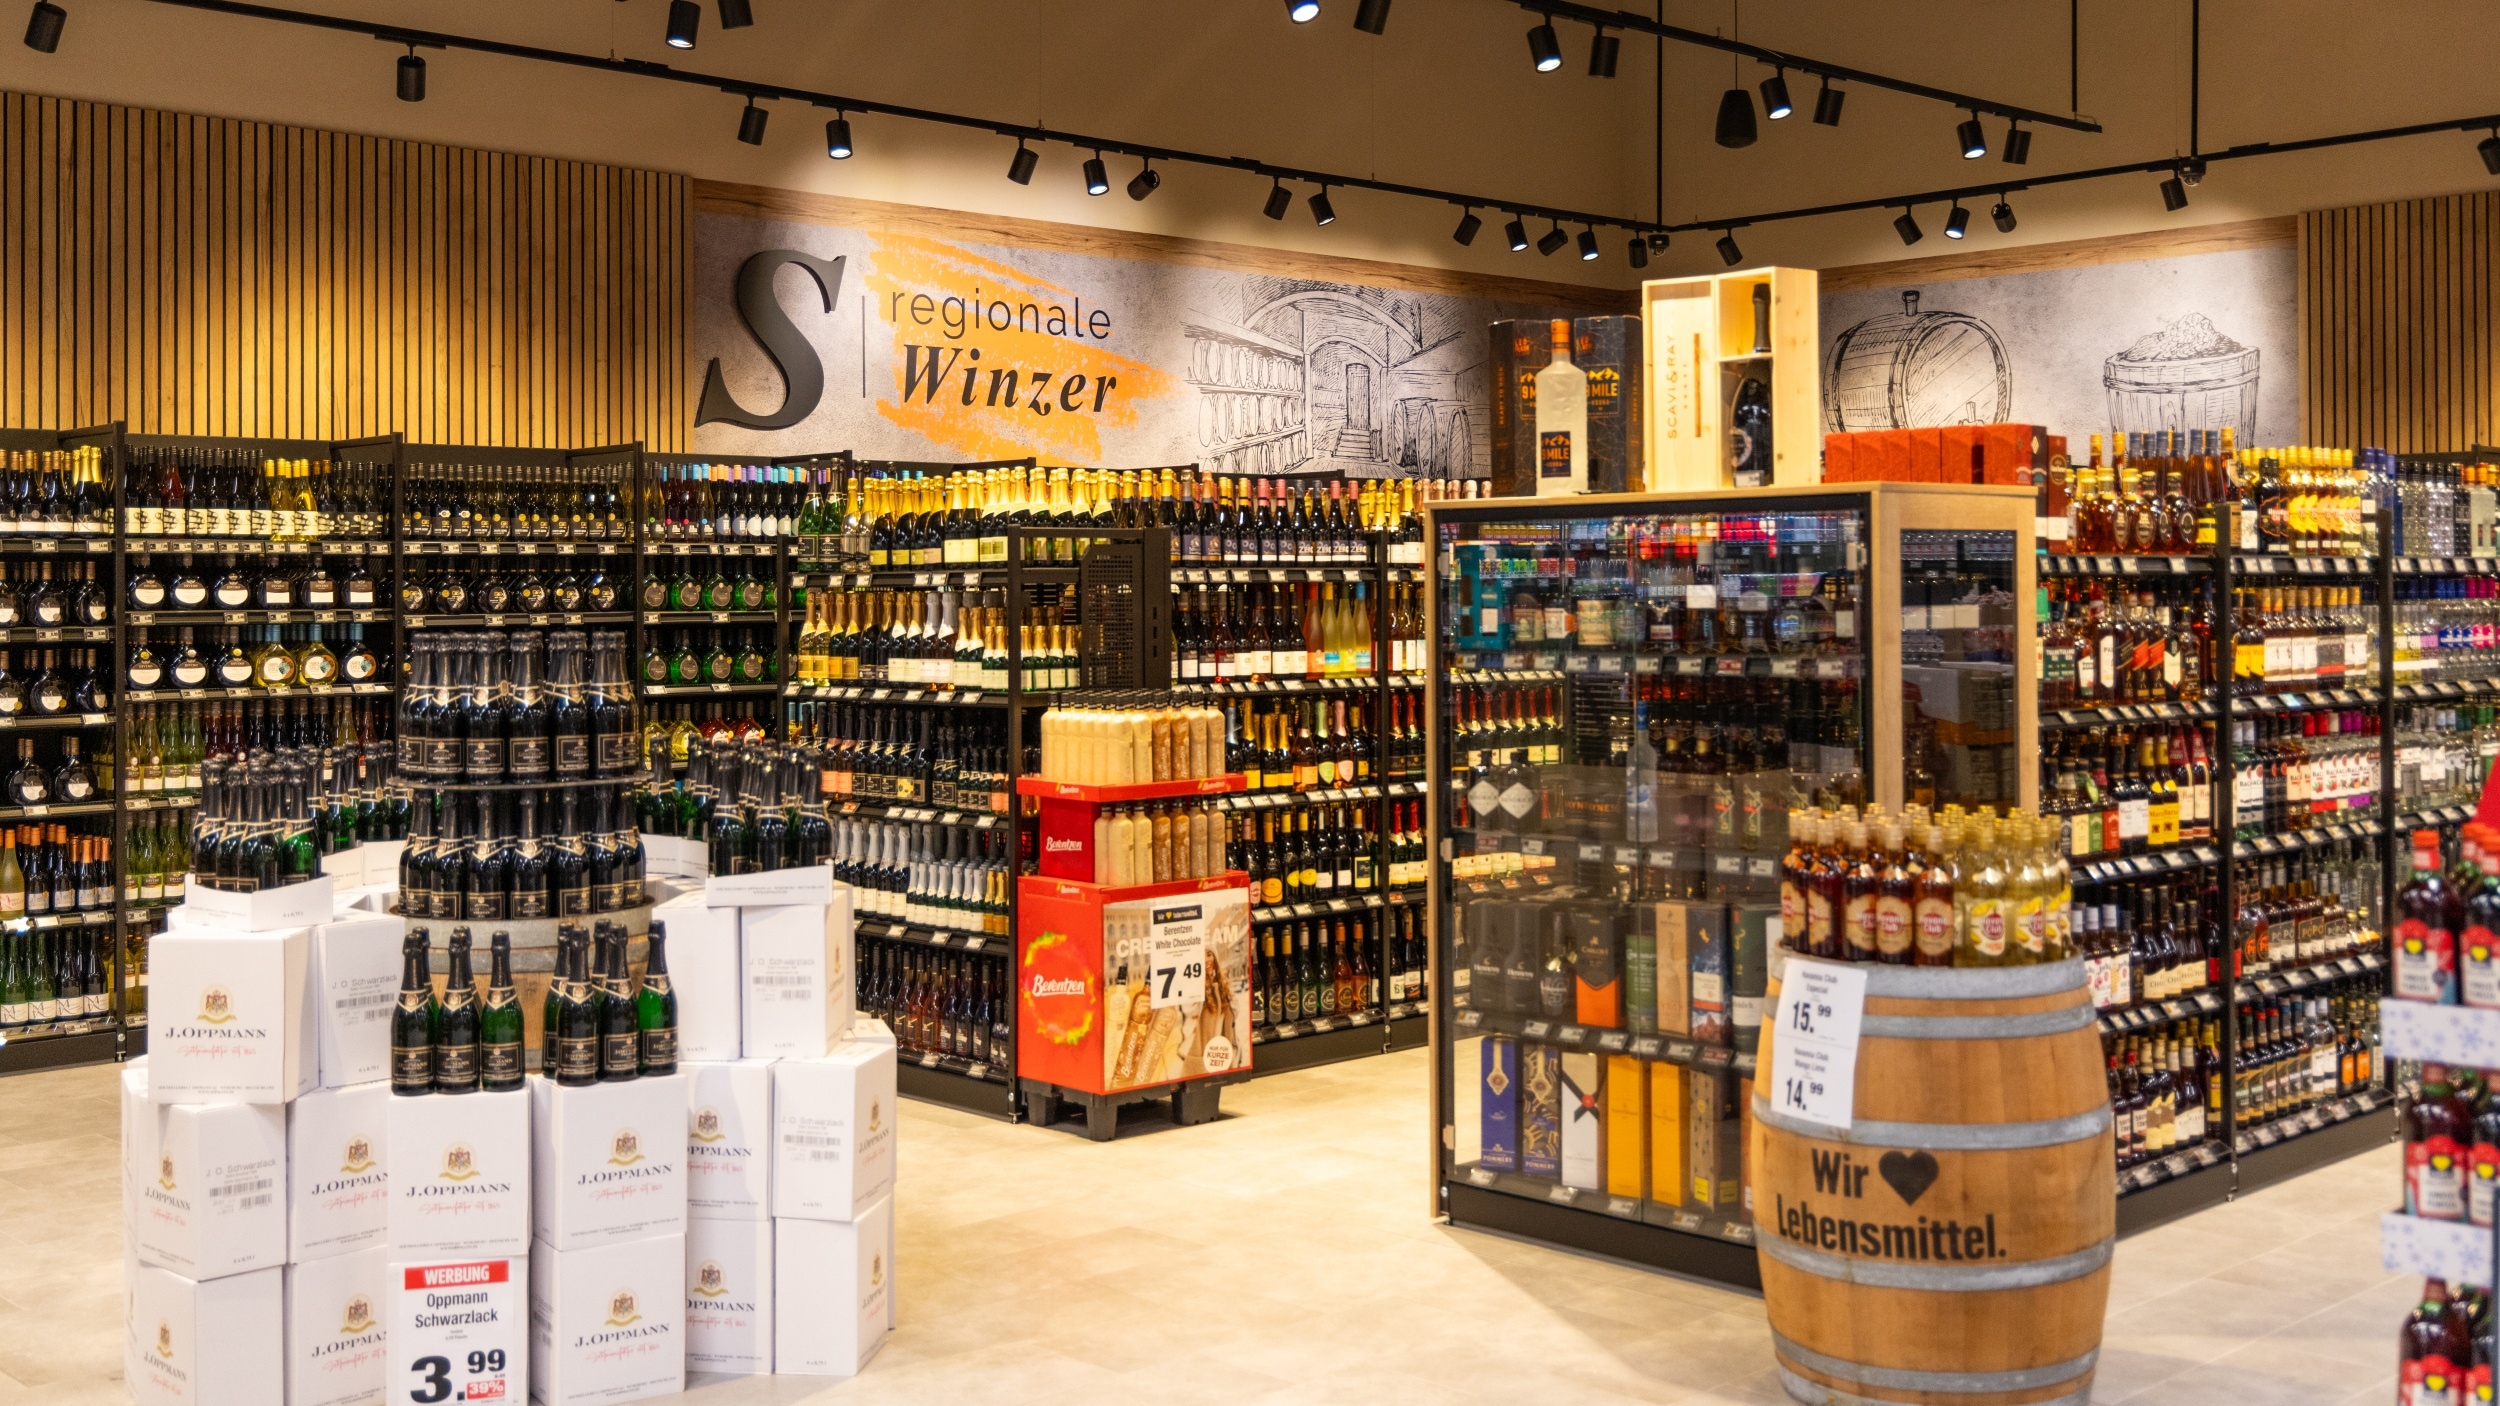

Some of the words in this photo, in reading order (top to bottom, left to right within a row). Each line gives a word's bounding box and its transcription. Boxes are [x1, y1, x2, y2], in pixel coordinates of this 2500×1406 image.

[892, 288, 1112, 340] regionale
[694, 249, 847, 431] S
[903, 344, 1118, 416] Winzer
[1591, 383, 1618, 397] MILE
[1547, 448, 1570, 460] MILE
[1046, 836, 1083, 852] Berentzen
[1163, 924, 1193, 936] Berentzen
[1155, 939, 1172, 950] White
[1173, 936, 1202, 949] Chocolate
[352, 974, 398, 987] Schwarzlack
[1032, 974, 1085, 998] Berentzen
[165, 1026, 266, 1040] J.OPPMANN
[1206, 1051, 1230, 1060] KURZE
[1210, 1058, 1225, 1067] ZEIT
[687, 1145, 752, 1158] PPMANN
[227, 1158, 276, 1174] Schwarzlack
[577, 1164, 673, 1186] J.OPPMANN
[1812, 1148, 1869, 1199] Wir
[312, 1173, 388, 1196] J.OPPMAN
[406, 1182, 511, 1198] J.OPPMANN
[145, 1186, 190, 1212] J.OPPMANN
[1776, 1194, 2006, 1260] Lebensmittel.
[424, 1266, 490, 1286] WERBUNG
[426, 1292, 488, 1310] Oppmann
[415, 1308, 498, 1328] Schwarzlack
[574, 1322, 670, 1348] J.OPPMANN
[312, 1332, 387, 1358] J.OPPMA
[468, 1380, 504, 1395] 39%
